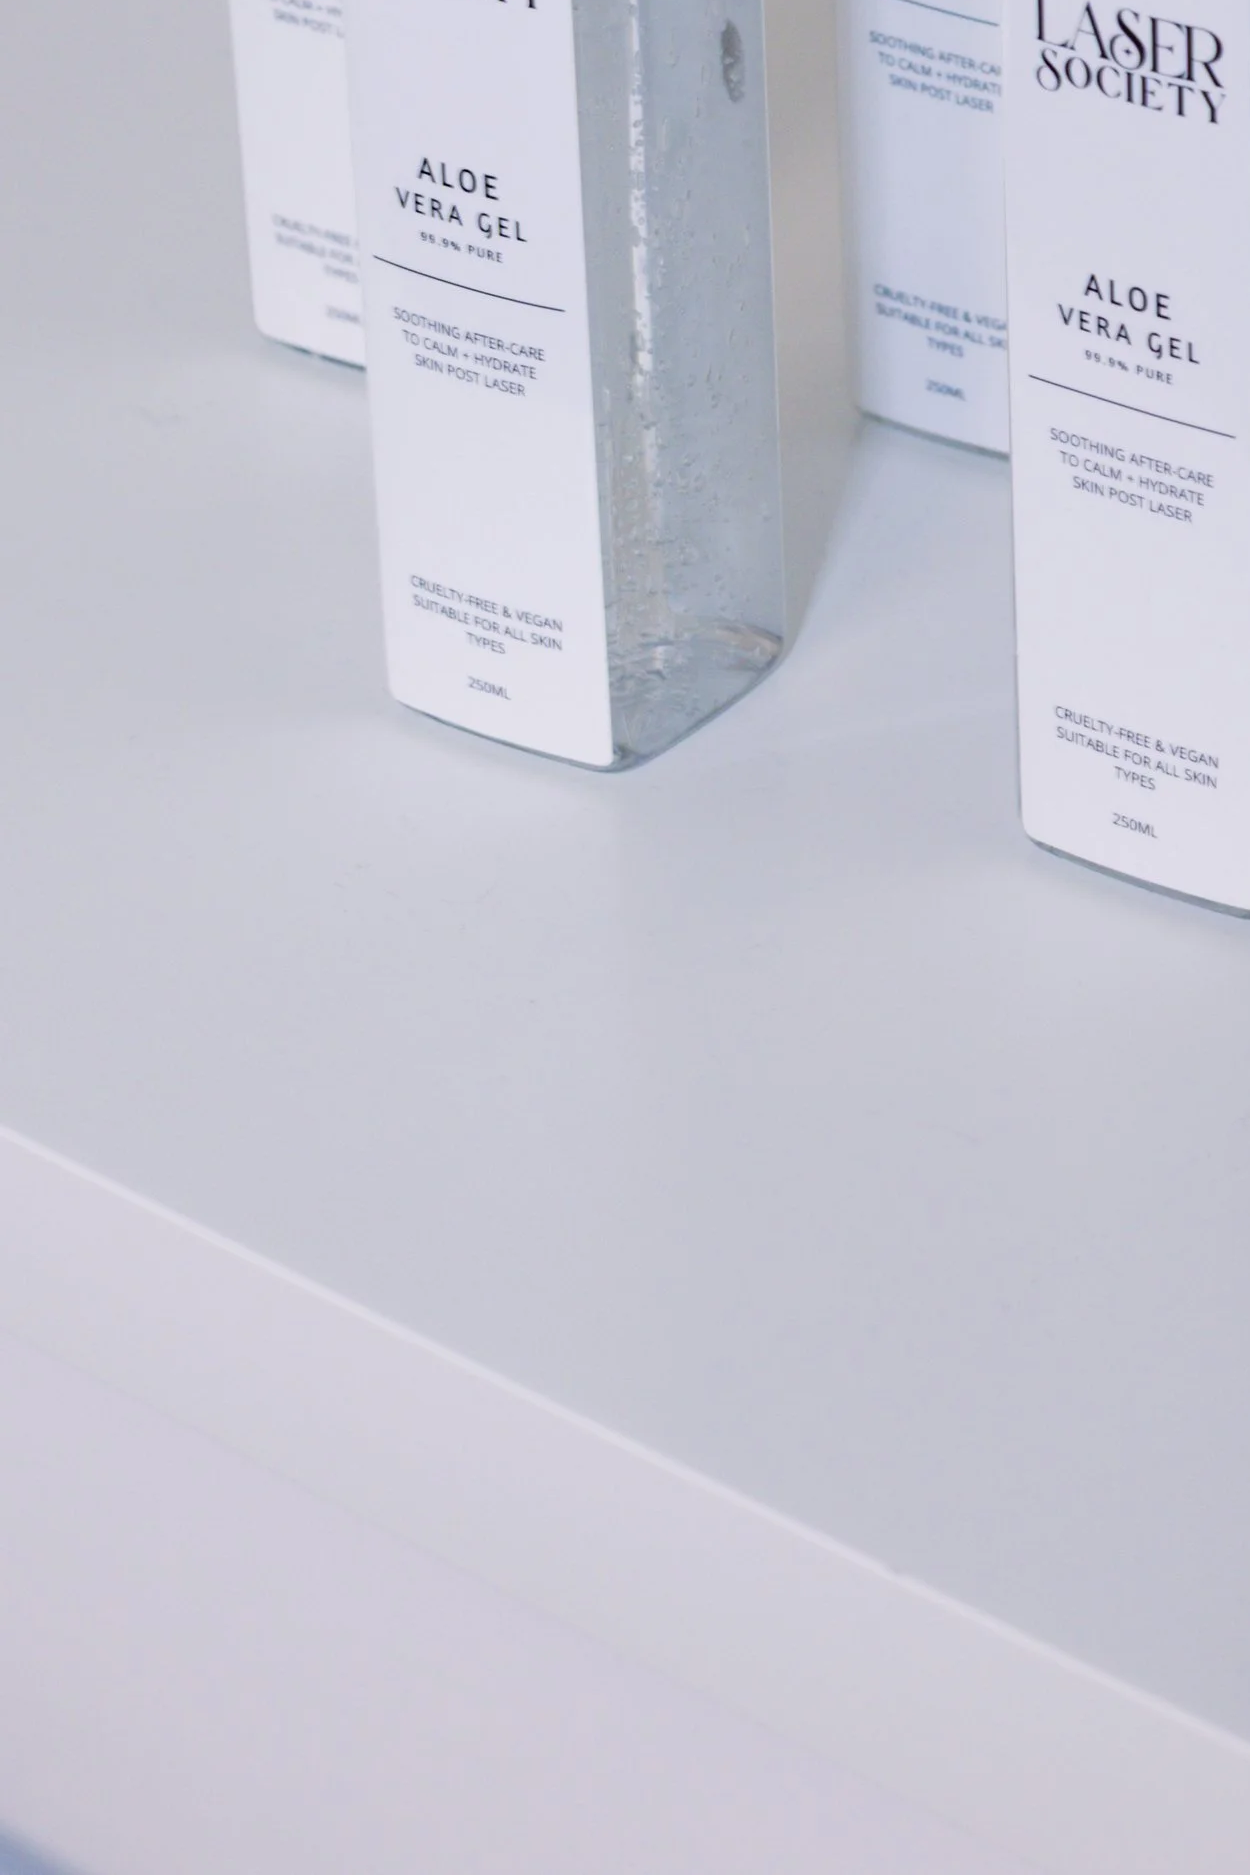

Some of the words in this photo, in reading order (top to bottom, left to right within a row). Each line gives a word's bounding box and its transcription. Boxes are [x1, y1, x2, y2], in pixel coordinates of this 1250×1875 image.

[938, 51, 1001, 76] AFTER-CA
[946, 73, 1001, 97] HYDRAT
[1036, 49, 1224, 124] SOCIETY
[418, 158, 498, 200] ALOE
[396, 187, 463, 226] VERA
[477, 213, 527, 242] GEL
[420, 232, 461, 251] 99.9%
[468, 245, 502, 263] PURE
[1084, 274, 1171, 320] ALOE
[393, 307, 460, 339] SOOTHING
[466, 331, 545, 361] AFTER-CARE
[402, 329, 420, 346] TO
[424, 338, 459, 358] CALM
[474, 353, 537, 379] HYDRATE
[1058, 304, 1131, 345] VERA
[1147, 332, 1199, 364] GEL
[415, 354, 444, 373] SKIN
[448, 364, 480, 384] POST
[485, 376, 525, 396] LASER
[1085, 350, 1129, 372] 99.9%
[1136, 365, 1172, 385] PURE
[1050, 428, 1125, 462] SOOTHING
[1129, 453, 1214, 488] AFTER-CARE
[1059, 450, 1079, 467] TO
[1083, 459, 1122, 481] CALM
[1139, 477, 1204, 506] HYDRATE
[1073, 476, 1104, 496] SKIN
[1108, 487, 1145, 508] POST
[1149, 500, 1192, 523] LASER
[410, 575, 497, 615] CRUELTY-FREE
[503, 606, 511, 618] &
[516, 611, 562, 632] VEGAN
[413, 594, 470, 625] SUITABLE
[474, 617, 500, 634] FOR
[505, 626, 527, 642] ALL
[531, 634, 562, 651] SKIN
[467, 632, 505, 654] TYPES
[468, 676, 511, 700] 250ML
[1055, 706, 1151, 749] CRUELTY-FREE
[1155, 740, 1165, 753] &
[1169, 744, 1218, 768] VEGAN
[1057, 726, 1119, 759] SUITABLE
[1123, 749, 1151, 769] FOR
[1155, 761, 1180, 778] ALL
[1184, 768, 1217, 789] SKIN
[1114, 766, 1156, 790] TYPES
[1113, 813, 1157, 838] 250ML
